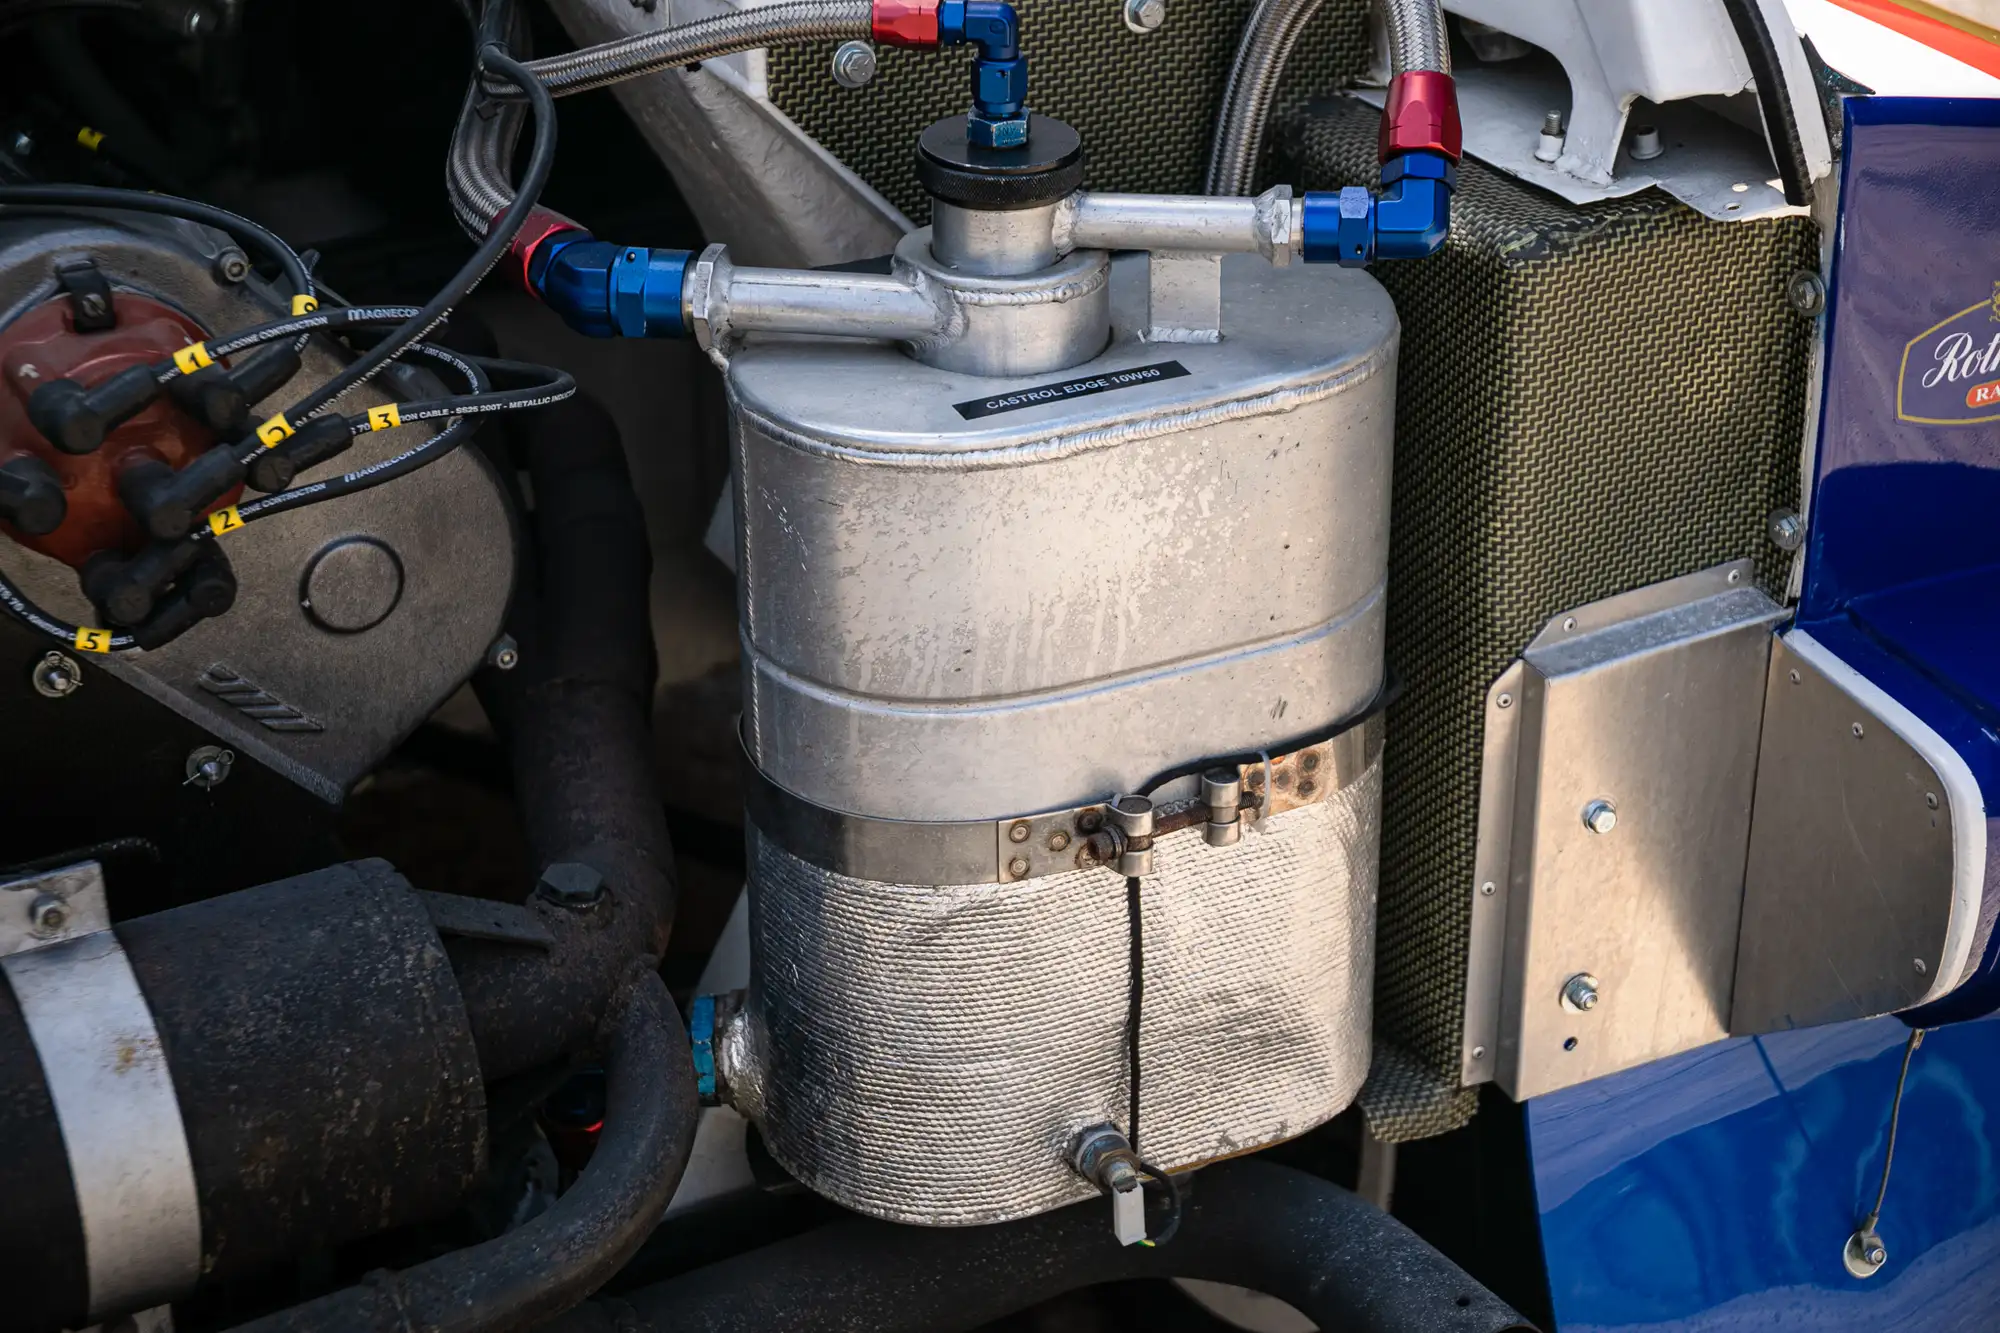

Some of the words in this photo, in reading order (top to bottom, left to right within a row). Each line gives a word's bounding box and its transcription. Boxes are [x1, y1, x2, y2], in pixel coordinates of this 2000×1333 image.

[187, 352, 201, 368] 1
[985, 388, 1063, 410] CASTROL
[1063, 378, 1110, 394] EDGE
[1111, 368, 1161, 384] 10W60
[419, 408, 449, 420] CABLE
[455, 404, 479, 415] SS25
[480, 402, 504, 413] 200T
[508, 395, 551, 410] METALLIC
[377, 412, 393, 430] 3
[217, 510, 236, 530] 2
[82, 632, 102, 650] 5
